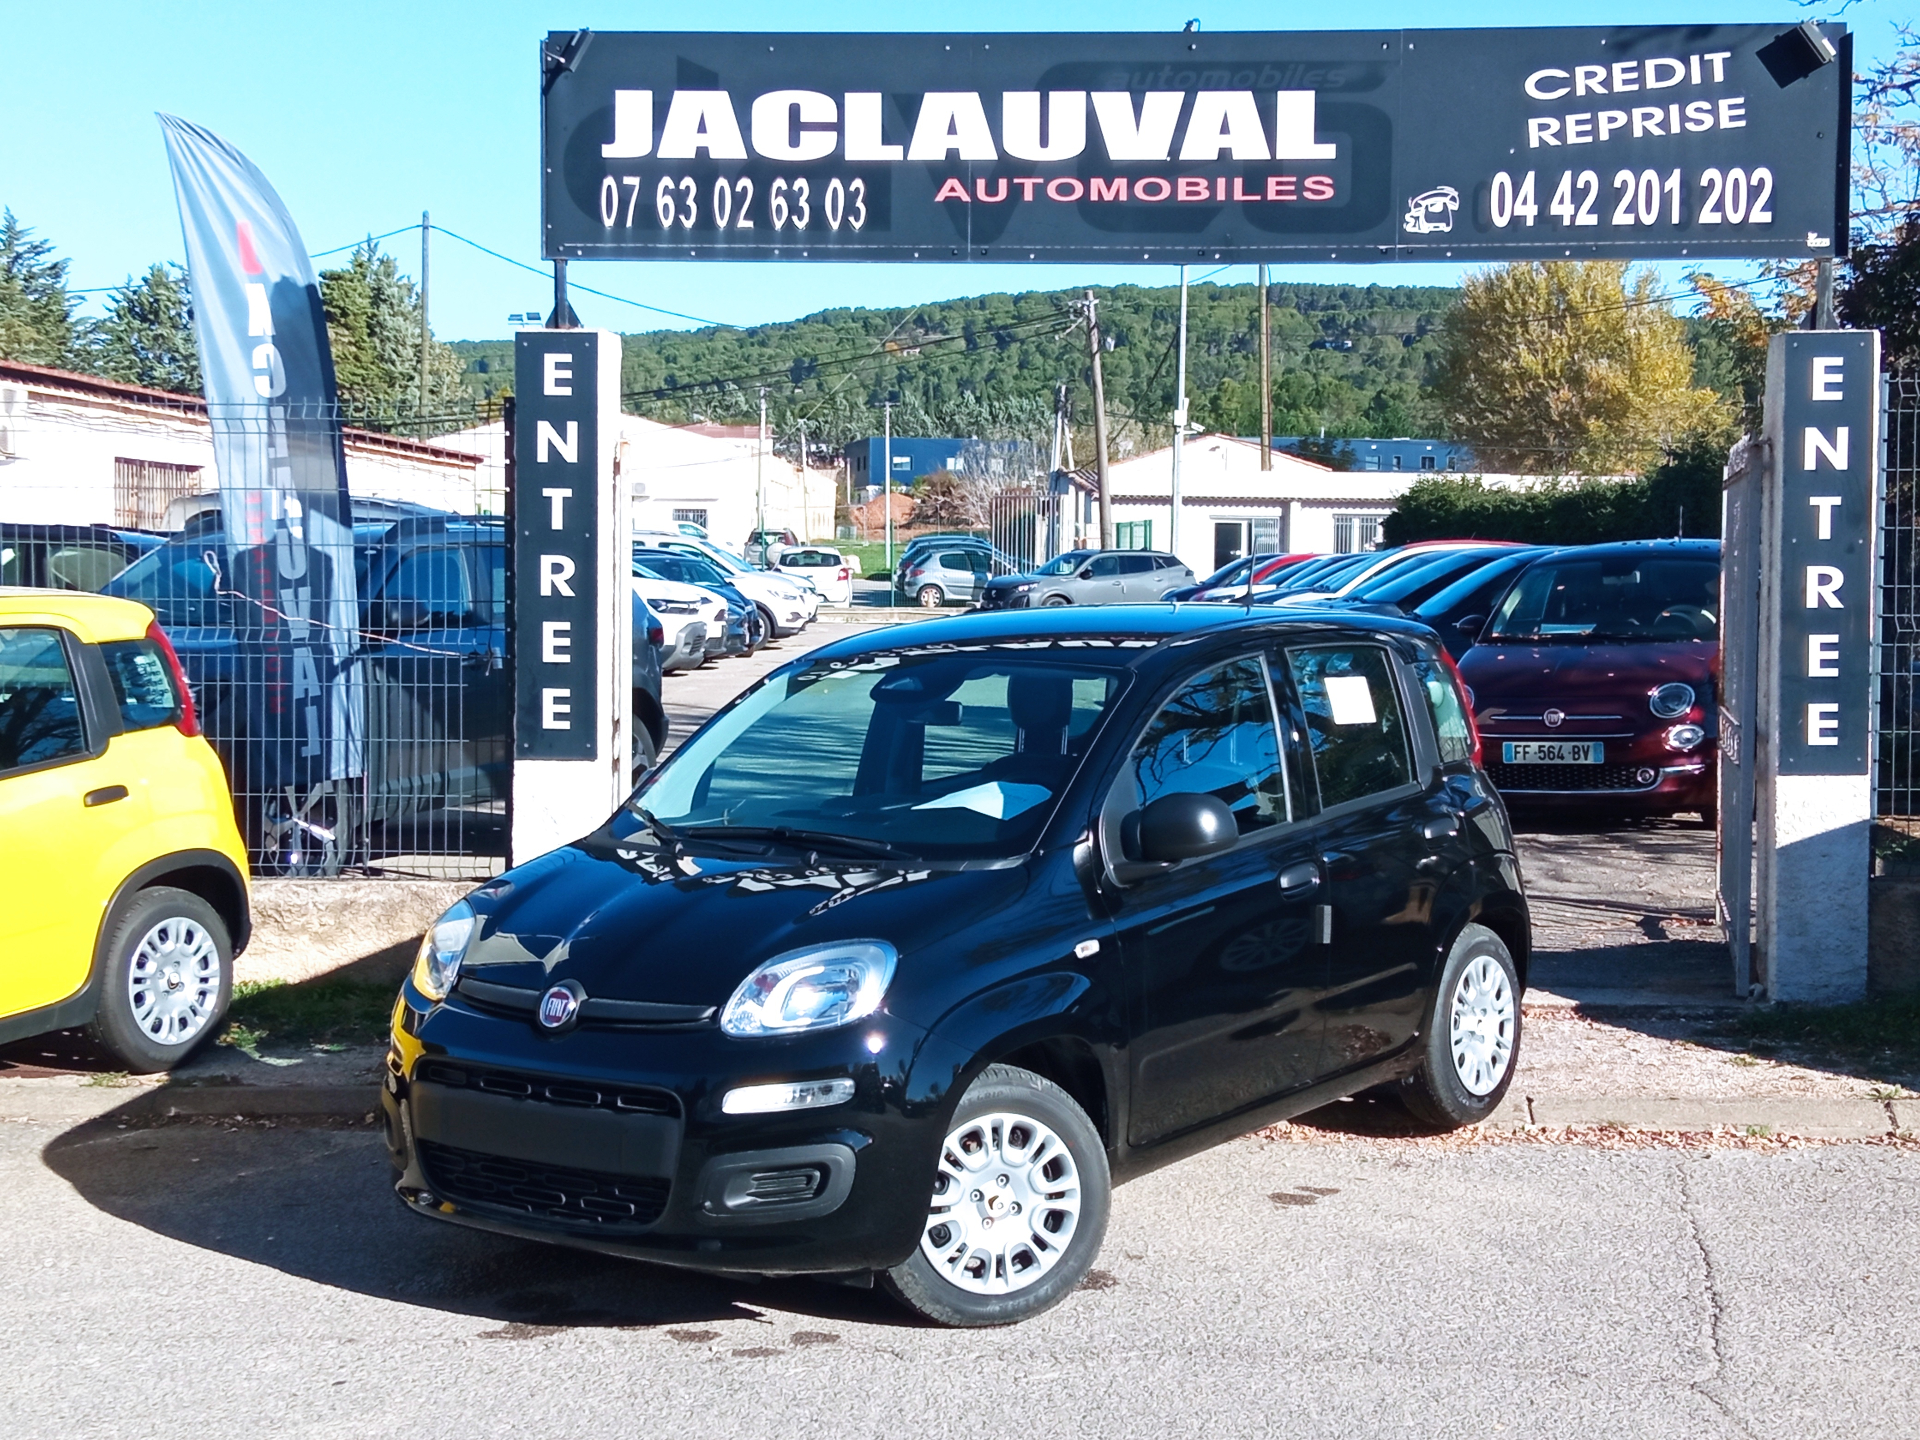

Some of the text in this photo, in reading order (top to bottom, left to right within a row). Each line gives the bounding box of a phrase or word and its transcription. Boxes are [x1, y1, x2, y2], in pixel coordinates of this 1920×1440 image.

[1524, 52, 1732, 100] CREDIT
[601, 89, 1336, 161] JACLAUVAL
[1528, 97, 1747, 149] REPRISE
[601, 175, 867, 231] 07 63 02 63 03
[934, 176, 1335, 202] AUTOMOBILES
[1490, 167, 1773, 228] 04 42 201 202
[536, 353, 579, 730] ENTREE
[1803, 356, 1849, 746] ENTREE
[545, 997, 568, 1017] FIAT
